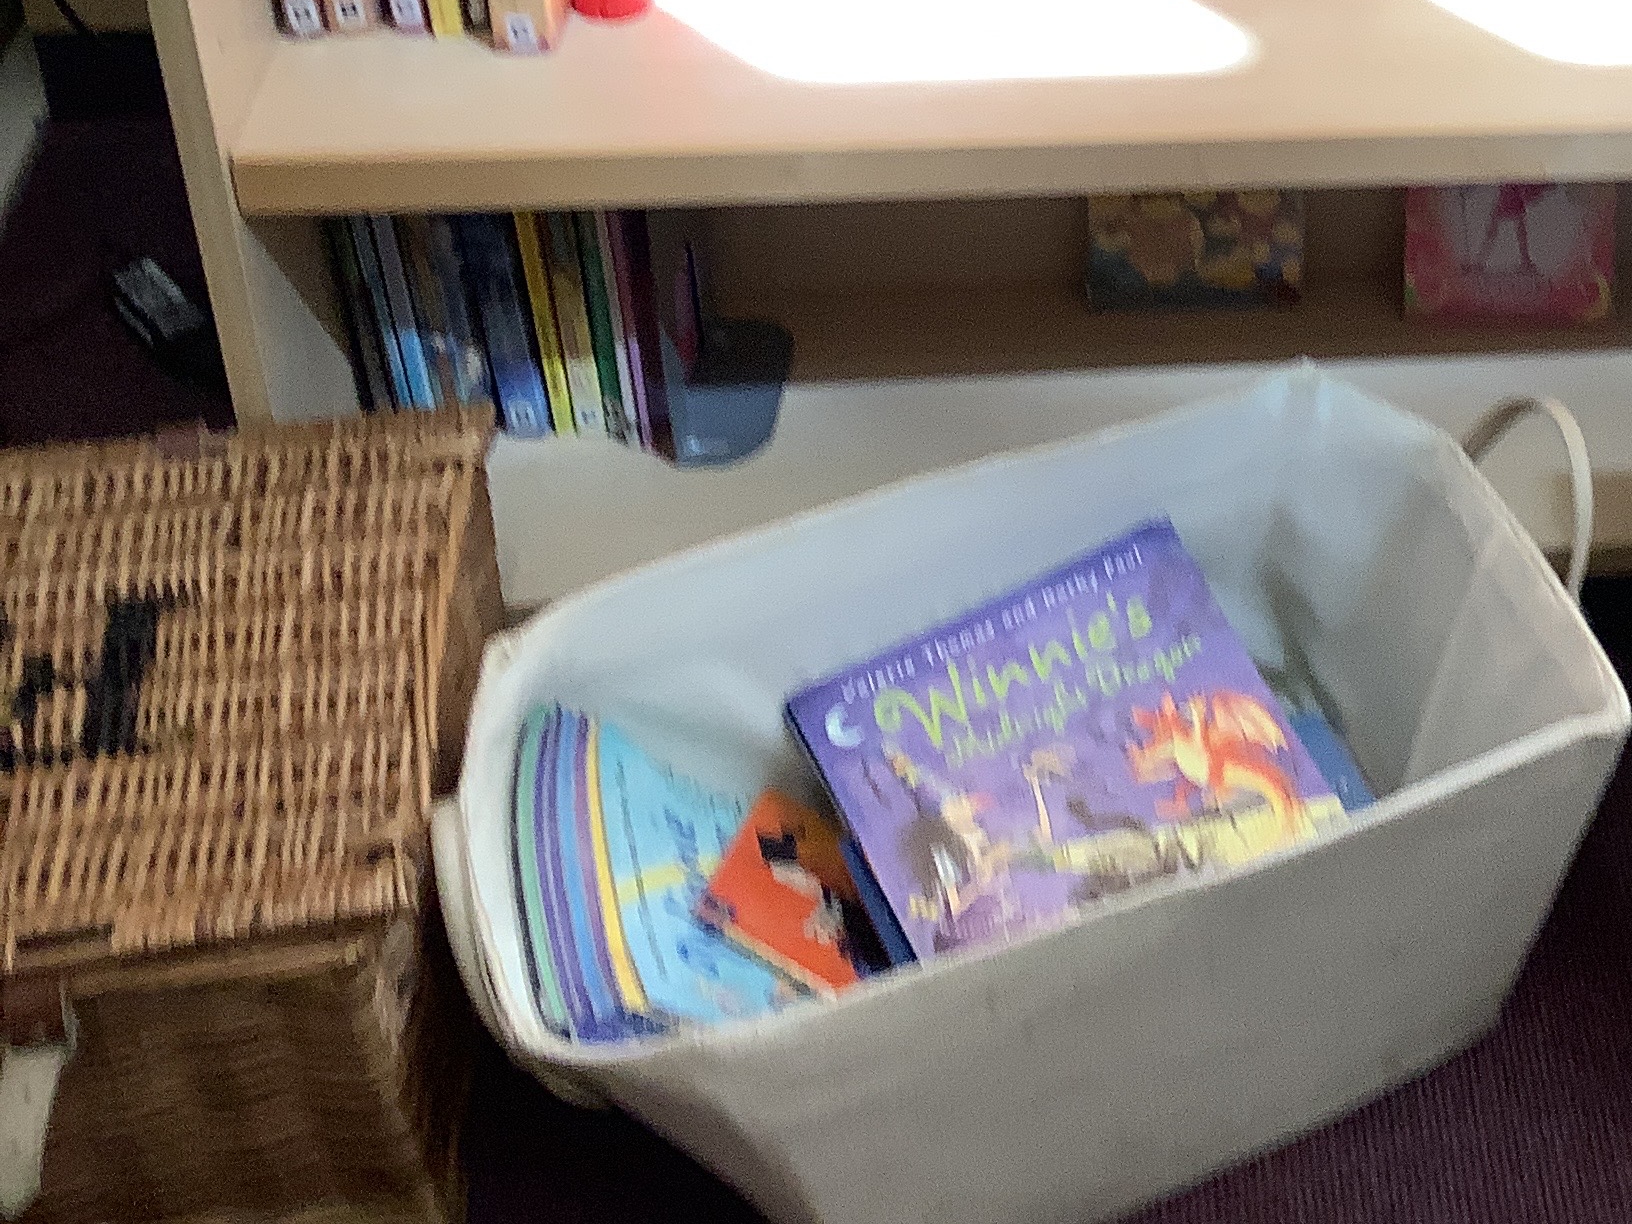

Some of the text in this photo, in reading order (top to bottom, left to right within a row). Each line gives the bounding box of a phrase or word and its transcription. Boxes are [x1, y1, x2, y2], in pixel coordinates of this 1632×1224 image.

[872, 588, 1153, 750] Winnie's
[920, 618, 996, 668] Thomas
[1001, 595, 1038, 632] and
[1102, 542, 1144, 582] Paul
